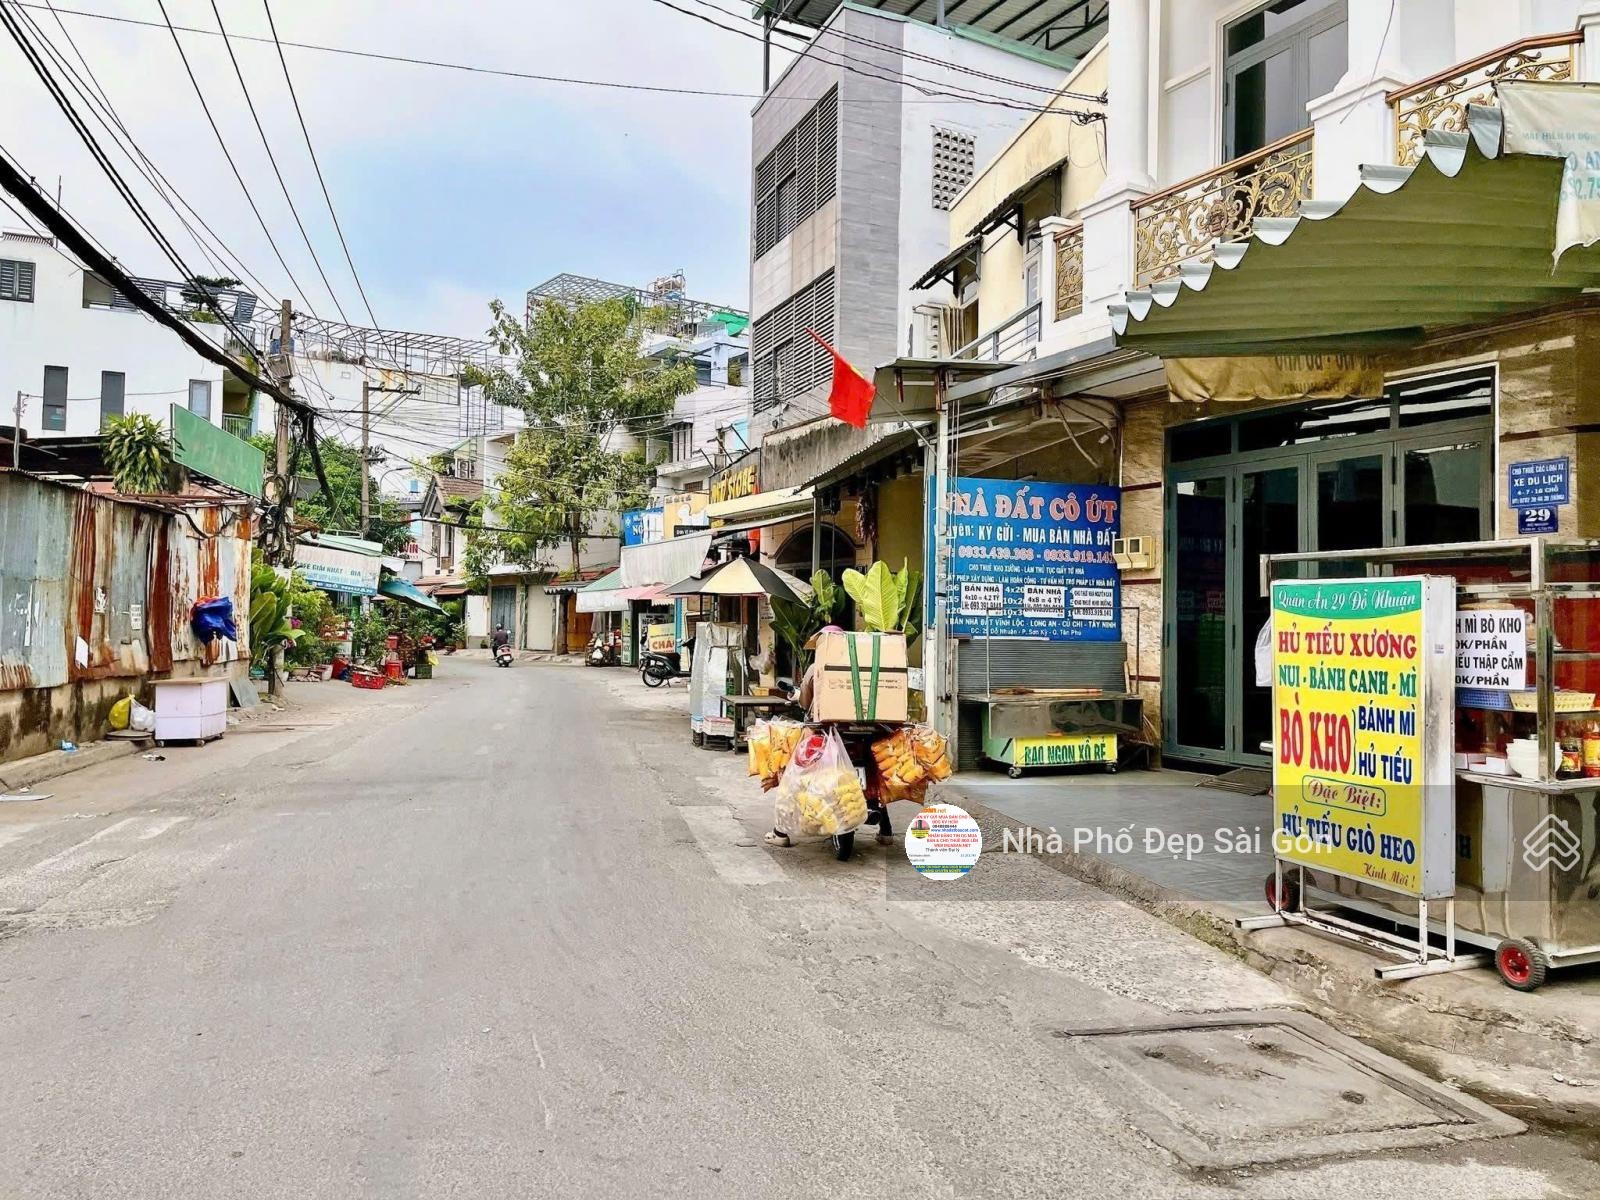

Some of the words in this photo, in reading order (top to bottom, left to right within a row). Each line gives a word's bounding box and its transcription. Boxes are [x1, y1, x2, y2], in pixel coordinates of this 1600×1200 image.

[1514, 478, 1525, 487] XE
[1527, 476, 1540, 486] DU
[1542, 474, 1563, 485] LỊCH
[995, 485, 1045, 520] ĐẤT
[1049, 492, 1081, 522] CÔ
[1085, 493, 1118, 523] ÚT
[1525, 508, 1551, 522] 29
[1023, 527, 1046, 544] MUA
[1073, 527, 1093, 545] NHÀ
[1097, 527, 1117, 546] ĐẤT
[964, 584, 982, 592] BÁN
[984, 584, 1000, 592] NHÀ
[1027, 586, 1044, 595] BÁN
[1046, 587, 1062, 595] NHÀ
[1278, 590, 1305, 608] Quán
[1332, 594, 1346, 610] 29
[1371, 588, 1416, 611] Nhuận
[1465, 614, 1477, 633] MÌ
[1481, 613, 1495, 634] BÒ
[1499, 617, 1522, 634] KHO
[652, 637, 674, 650] CHÁ
[1278, 622, 1301, 653] HỦ
[1350, 628, 1417, 660] XƯƠNG
[1473, 653, 1498, 671] THẬP
[1278, 664, 1300, 688] NUI
[1309, 661, 1346, 692] BÁNH
[1349, 669, 1388, 696] CANH
[1399, 666, 1417, 698] MÌ
[1358, 700, 1395, 734] BÁNH
[1400, 704, 1416, 737] MÌ
[1279, 692, 1304, 766] BÒ
[1309, 711, 1351, 775] KHO
[1047, 744, 1076, 765] NGON
[1358, 743, 1376, 778] HỦ
[1380, 746, 1412, 785] TIẾU
[1282, 804, 1302, 838] HỦ
[1306, 810, 1342, 848] TIẾU
[1346, 823, 1376, 855] GIÒ
[1380, 833, 1416, 865] HEO
